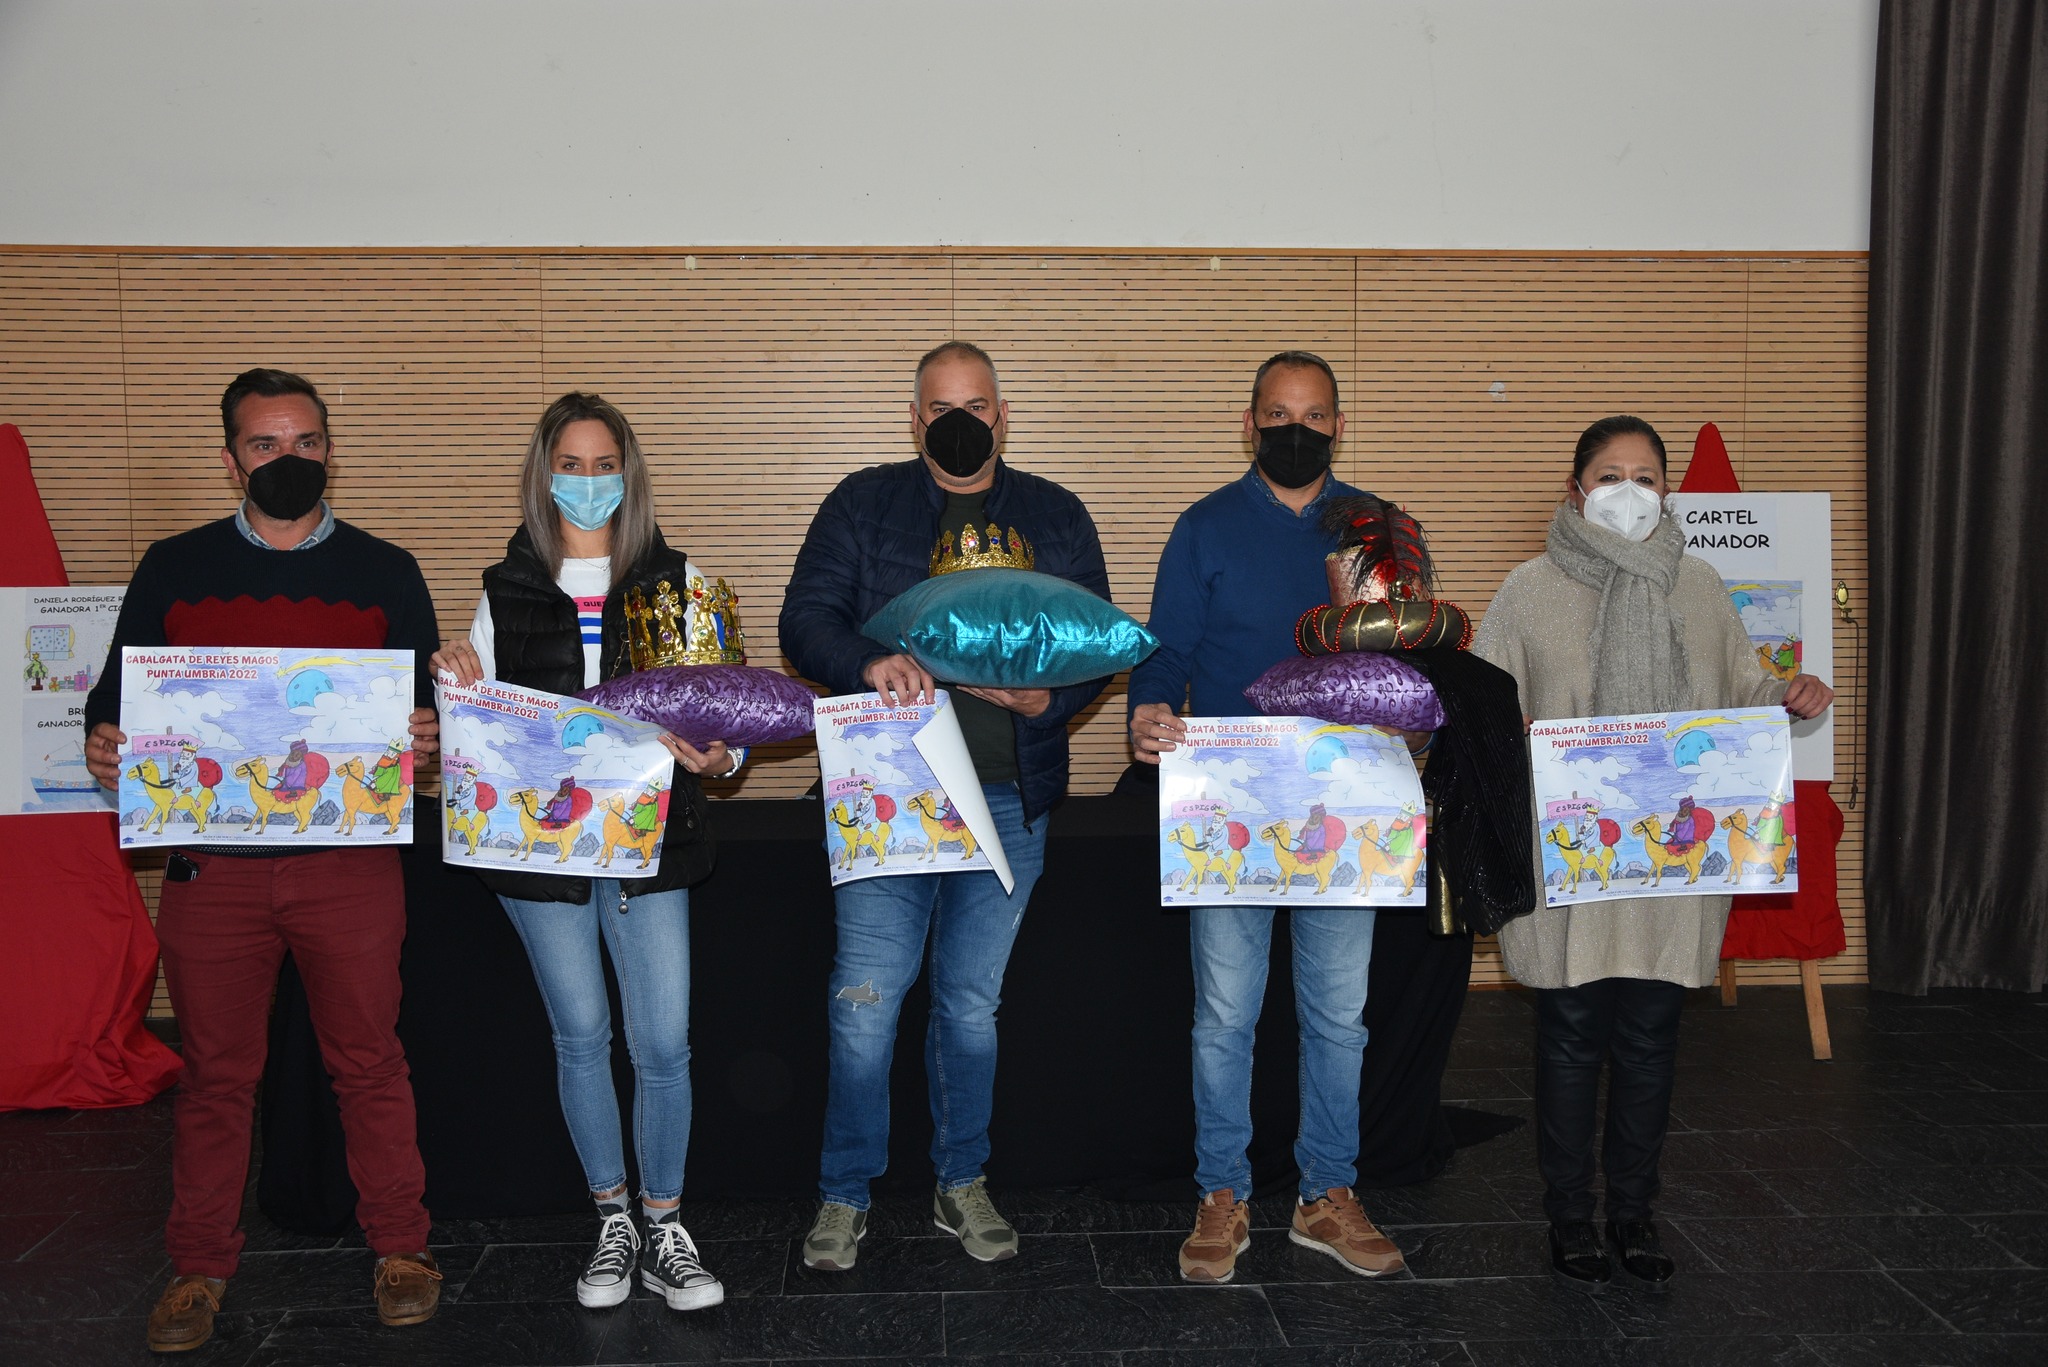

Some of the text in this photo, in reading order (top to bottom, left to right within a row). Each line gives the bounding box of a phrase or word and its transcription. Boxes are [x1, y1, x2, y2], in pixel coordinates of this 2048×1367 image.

[1686, 510, 1758, 524] CARTEL
[1685, 534, 1770, 548] ANADOR
[71, 595, 116, 603] RODRÍGUEZ
[40, 605, 91, 614] GANADORA
[126, 655, 279, 665] CABALGATA DE REYES MAGOS
[147, 669, 182, 679] PUNTA
[229, 669, 257, 679] 2022
[444, 691, 473, 705] PUNTA
[514, 706, 539, 719] 2022
[481, 686, 493, 696] DE
[495, 688, 524, 702] REYES
[527, 696, 559, 710] MAGOS
[816, 701, 860, 715] CABALGATA
[862, 700, 872, 709] DE
[833, 716, 857, 726] PUNTA
[896, 711, 919, 720] 2022
[1217, 725, 1230, 734] DE
[1233, 724, 1262, 733] REYES
[1265, 724, 1298, 733] MAGOS
[1533, 720, 1667, 736] CABALGATA DE REYES MAGOS
[1254, 737, 1279, 747] 2022
[1552, 739, 1583, 748] PUNTA
[1624, 734, 1648, 744] 2022
[443, 759, 473, 769] SPIGÓN
